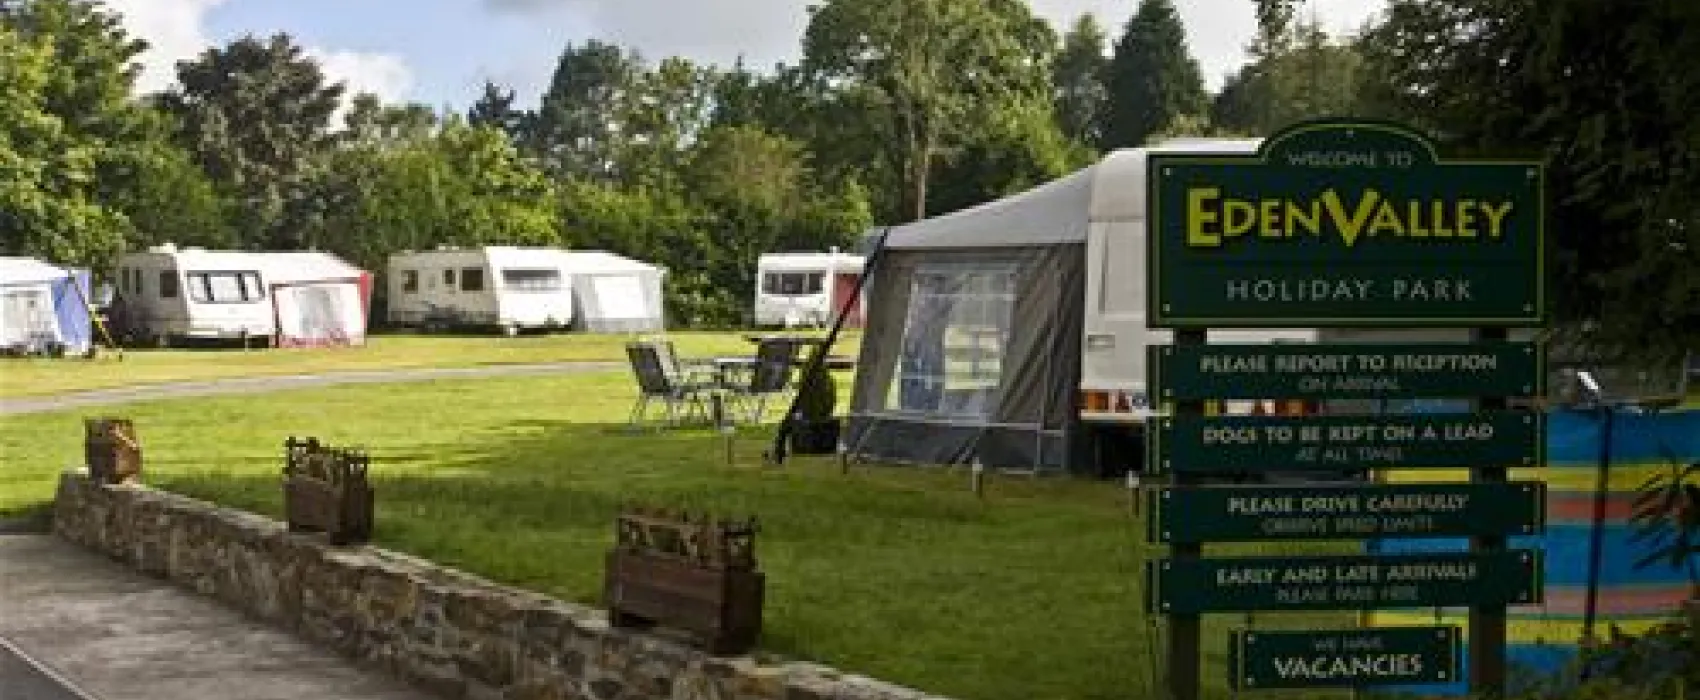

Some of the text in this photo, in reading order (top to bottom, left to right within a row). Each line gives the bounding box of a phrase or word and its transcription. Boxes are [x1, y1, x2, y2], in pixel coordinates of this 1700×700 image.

[1287, 150, 1376, 167] WELCOME
[1226, 279, 1472, 301] HOLIDAY PARK
[1200, 354, 1497, 372] PLEASE REPORT TO RECEPTION
[1202, 424, 1494, 444] DOGS TO BE KEPT ON A LEAD
[1227, 494, 1468, 513] PLEASE DRIVE CAREFULLY
[1216, 563, 1477, 584] EARLY AND LATE ARRIVALS
[1273, 654, 1424, 679] VACANCIES
